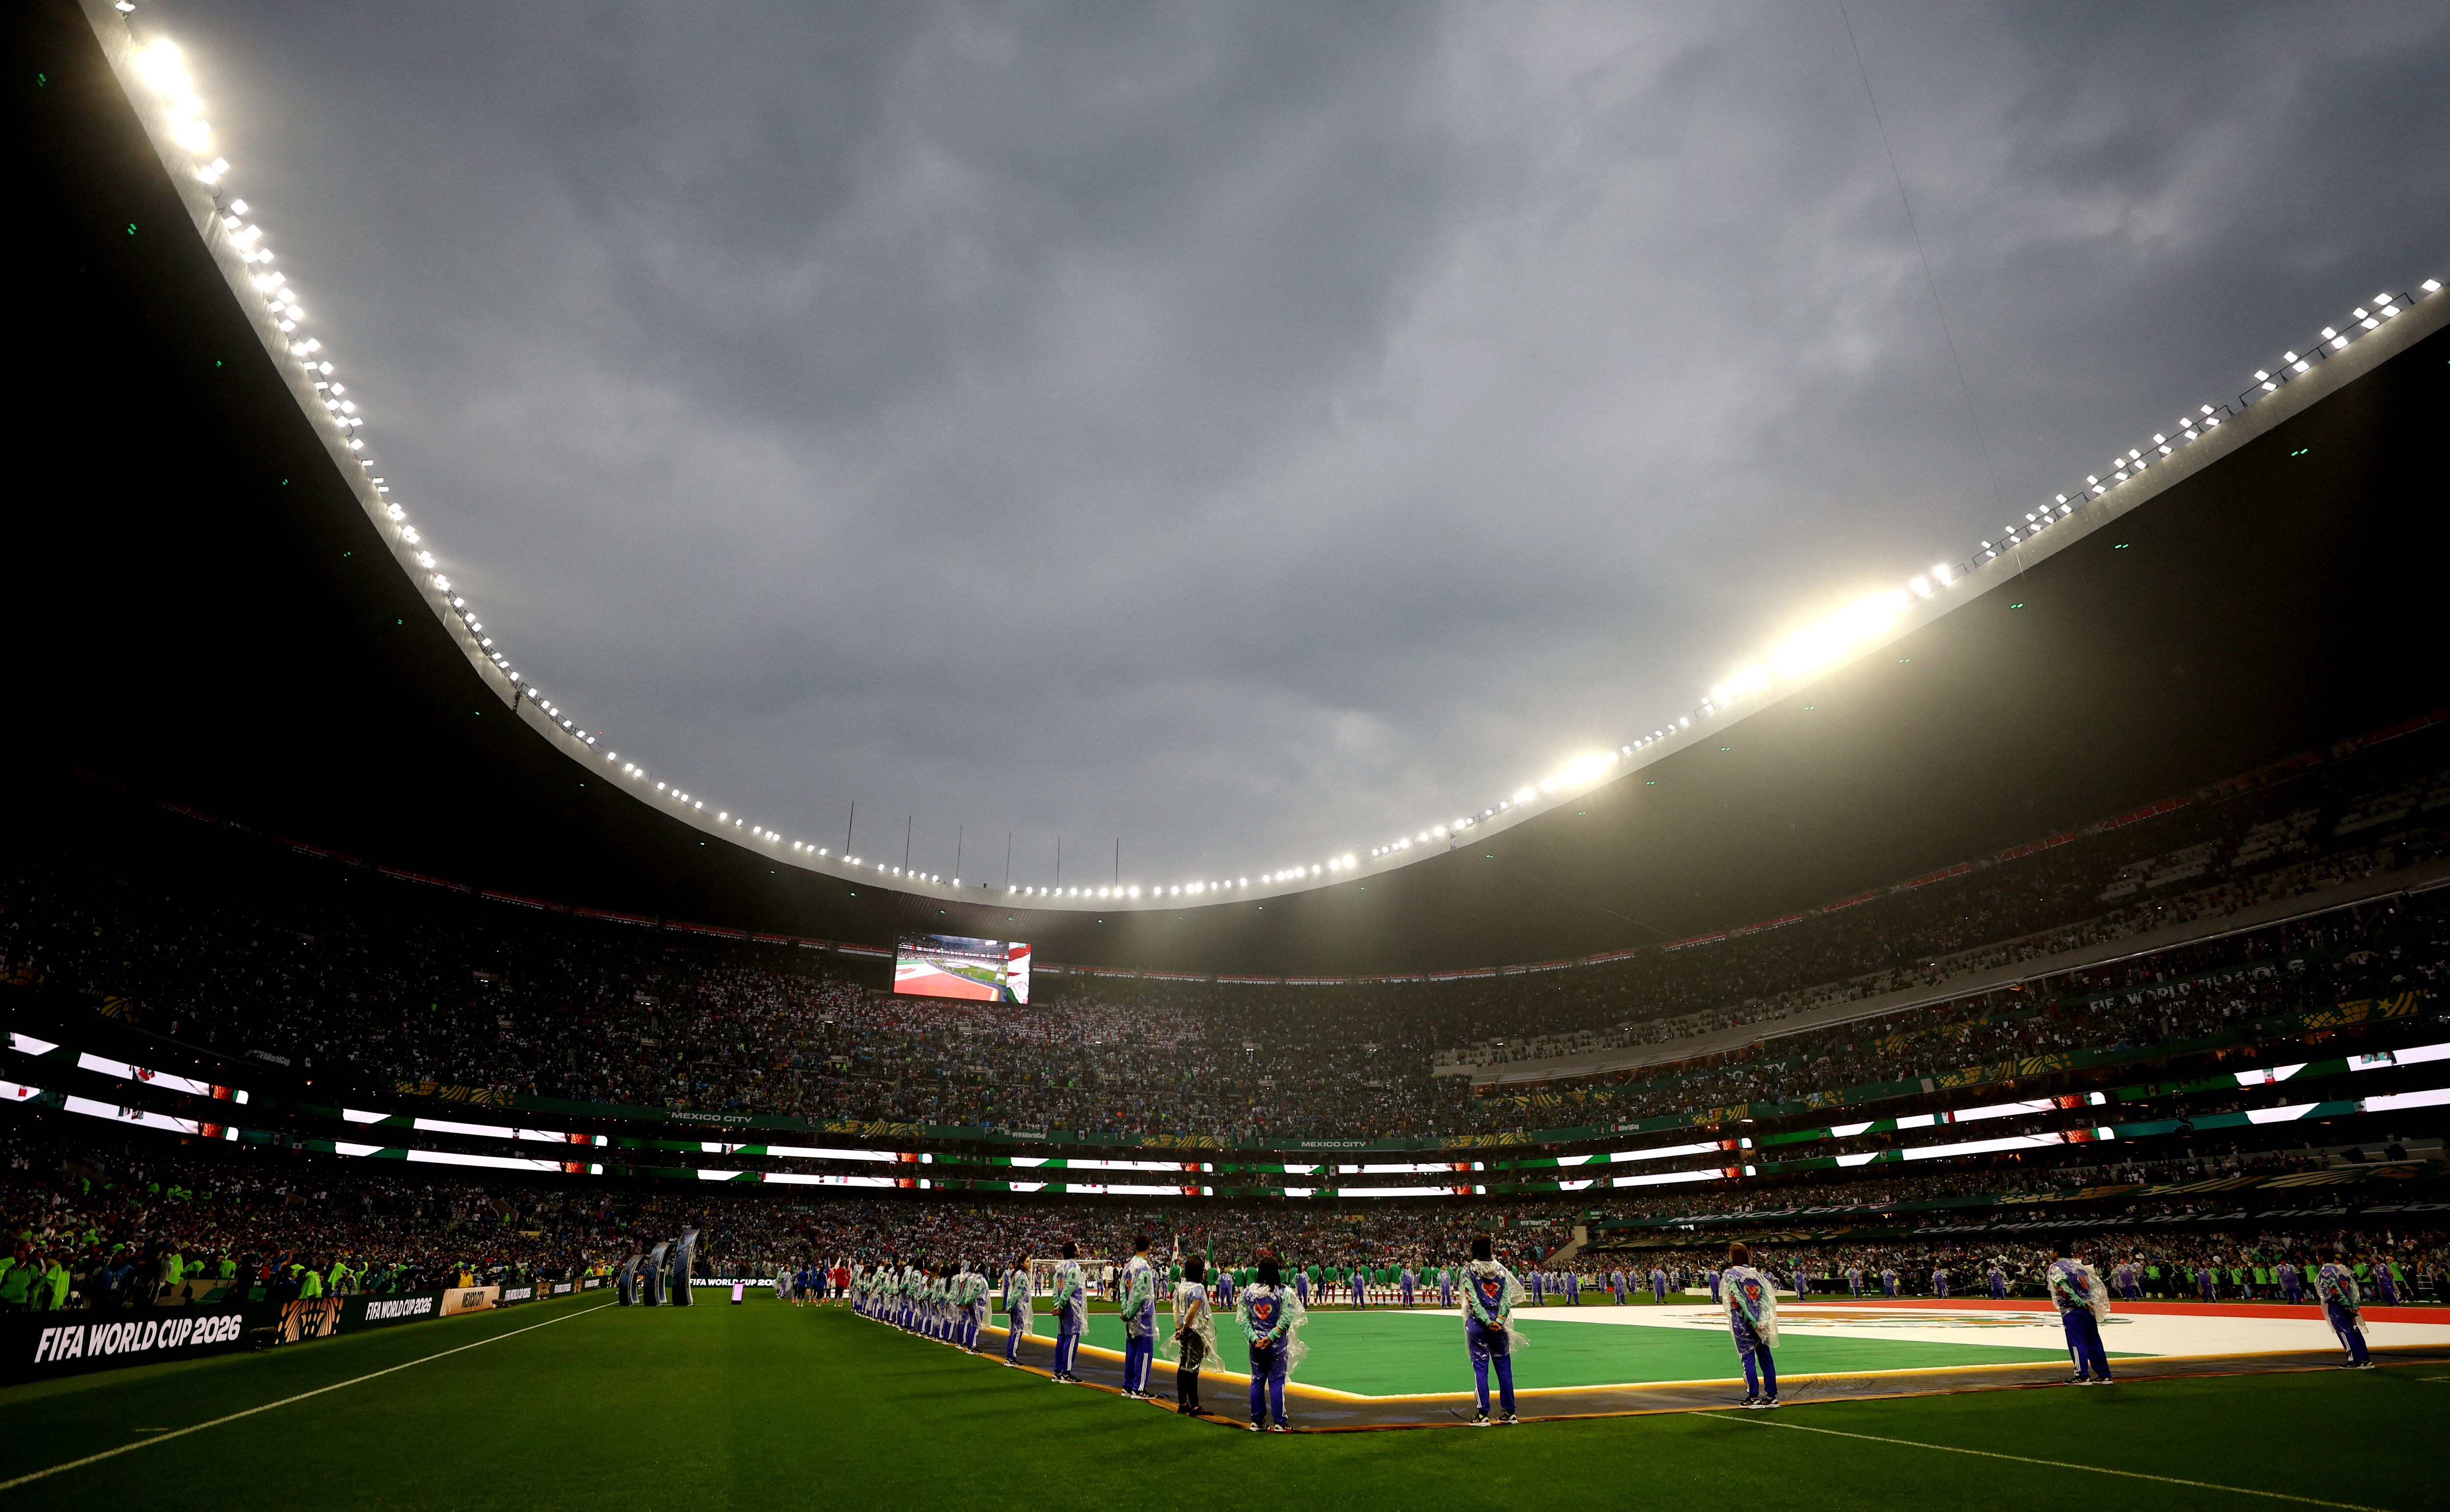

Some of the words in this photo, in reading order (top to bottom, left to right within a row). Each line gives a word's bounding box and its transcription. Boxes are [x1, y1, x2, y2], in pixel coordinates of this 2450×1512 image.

[671, 1112, 721, 1121] MEXICO
[1667, 1207, 1804, 1223] MEXICO
[1913, 1222, 1987, 1234] COPA
[1990, 1215, 2135, 1231] MUNDIAL
[2142, 1214, 2196, 1223] DE
[2198, 1212, 2247, 1221] LA
[2254, 1205, 2350, 1218] FIFA
[365, 1301, 382, 1321] FIFA
[380, 1300, 404, 1318] WORLD
[402, 1299, 416, 1317] CUP
[413, 1296, 432, 1315] 2026
[34, 1325, 85, 1364] FIFA
[88, 1320, 157, 1357] WORLD
[157, 1318, 193, 1349] CUP
[190, 1314, 243, 1345] 2026
